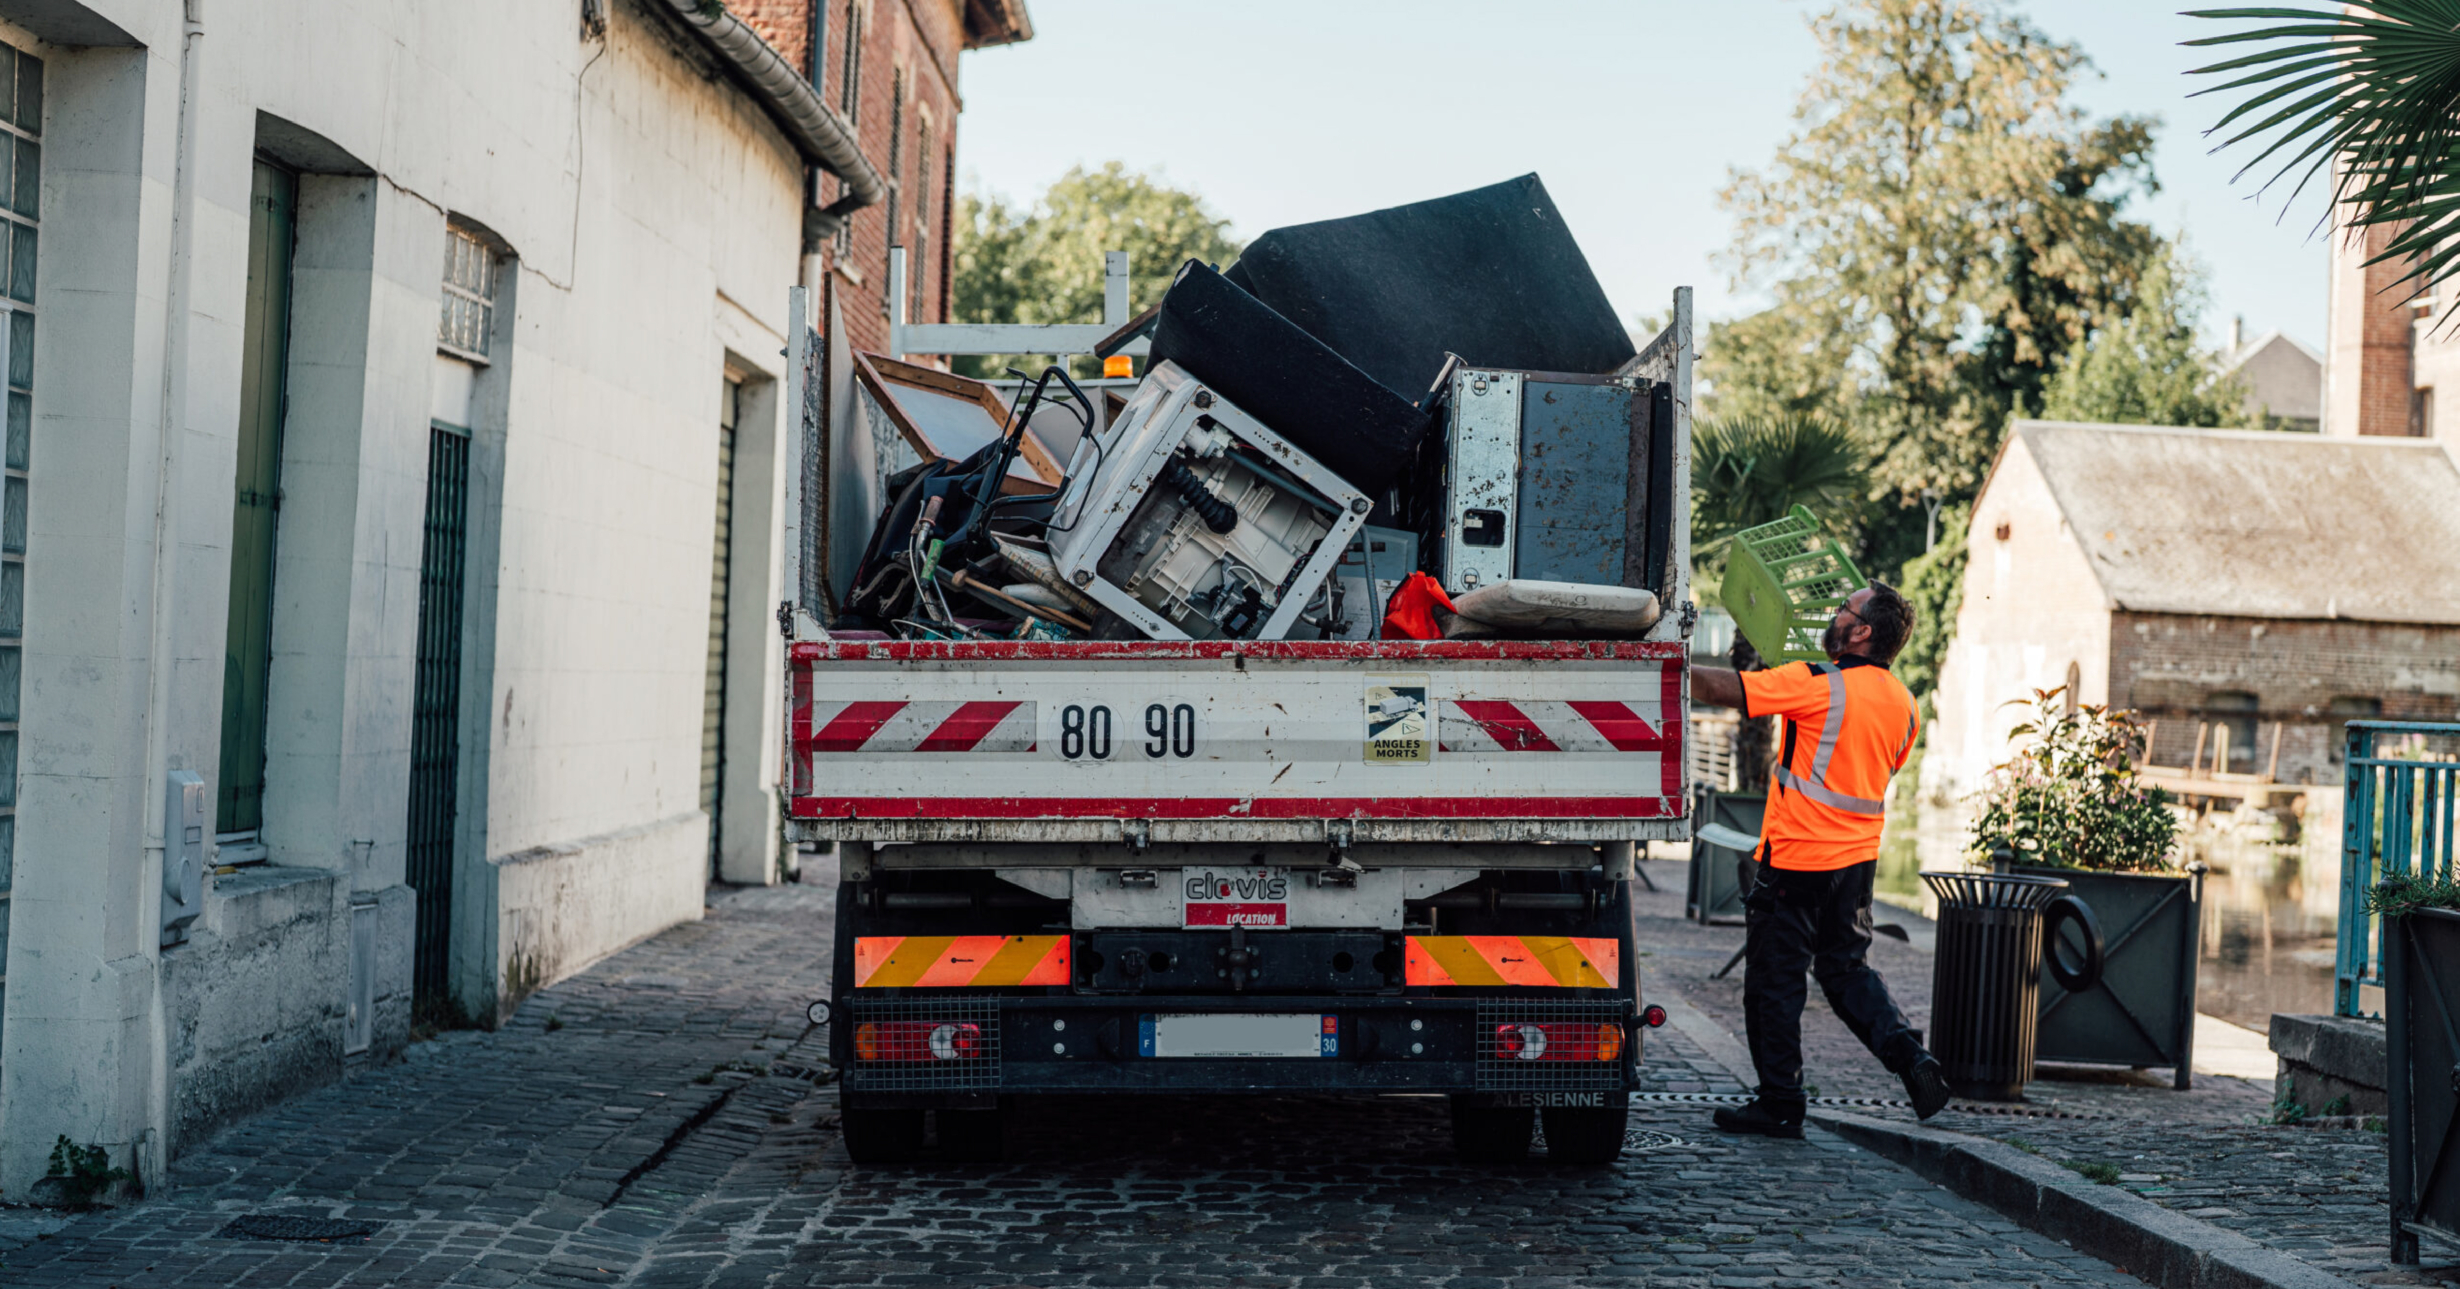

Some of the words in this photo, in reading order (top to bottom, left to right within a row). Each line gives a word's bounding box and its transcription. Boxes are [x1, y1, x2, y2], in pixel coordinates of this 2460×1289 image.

[1061, 704, 1111, 760] 80
[1144, 703, 1195, 759] 90
[1374, 739, 1421, 749] ANGLES
[1376, 749, 1418, 758] MORTS
[1226, 913, 1277, 925] LOCATION
[1143, 1039, 1150, 1048] F
[1322, 1037, 1337, 1053] 30
[1492, 1092, 1605, 1107] ALESIENNE
